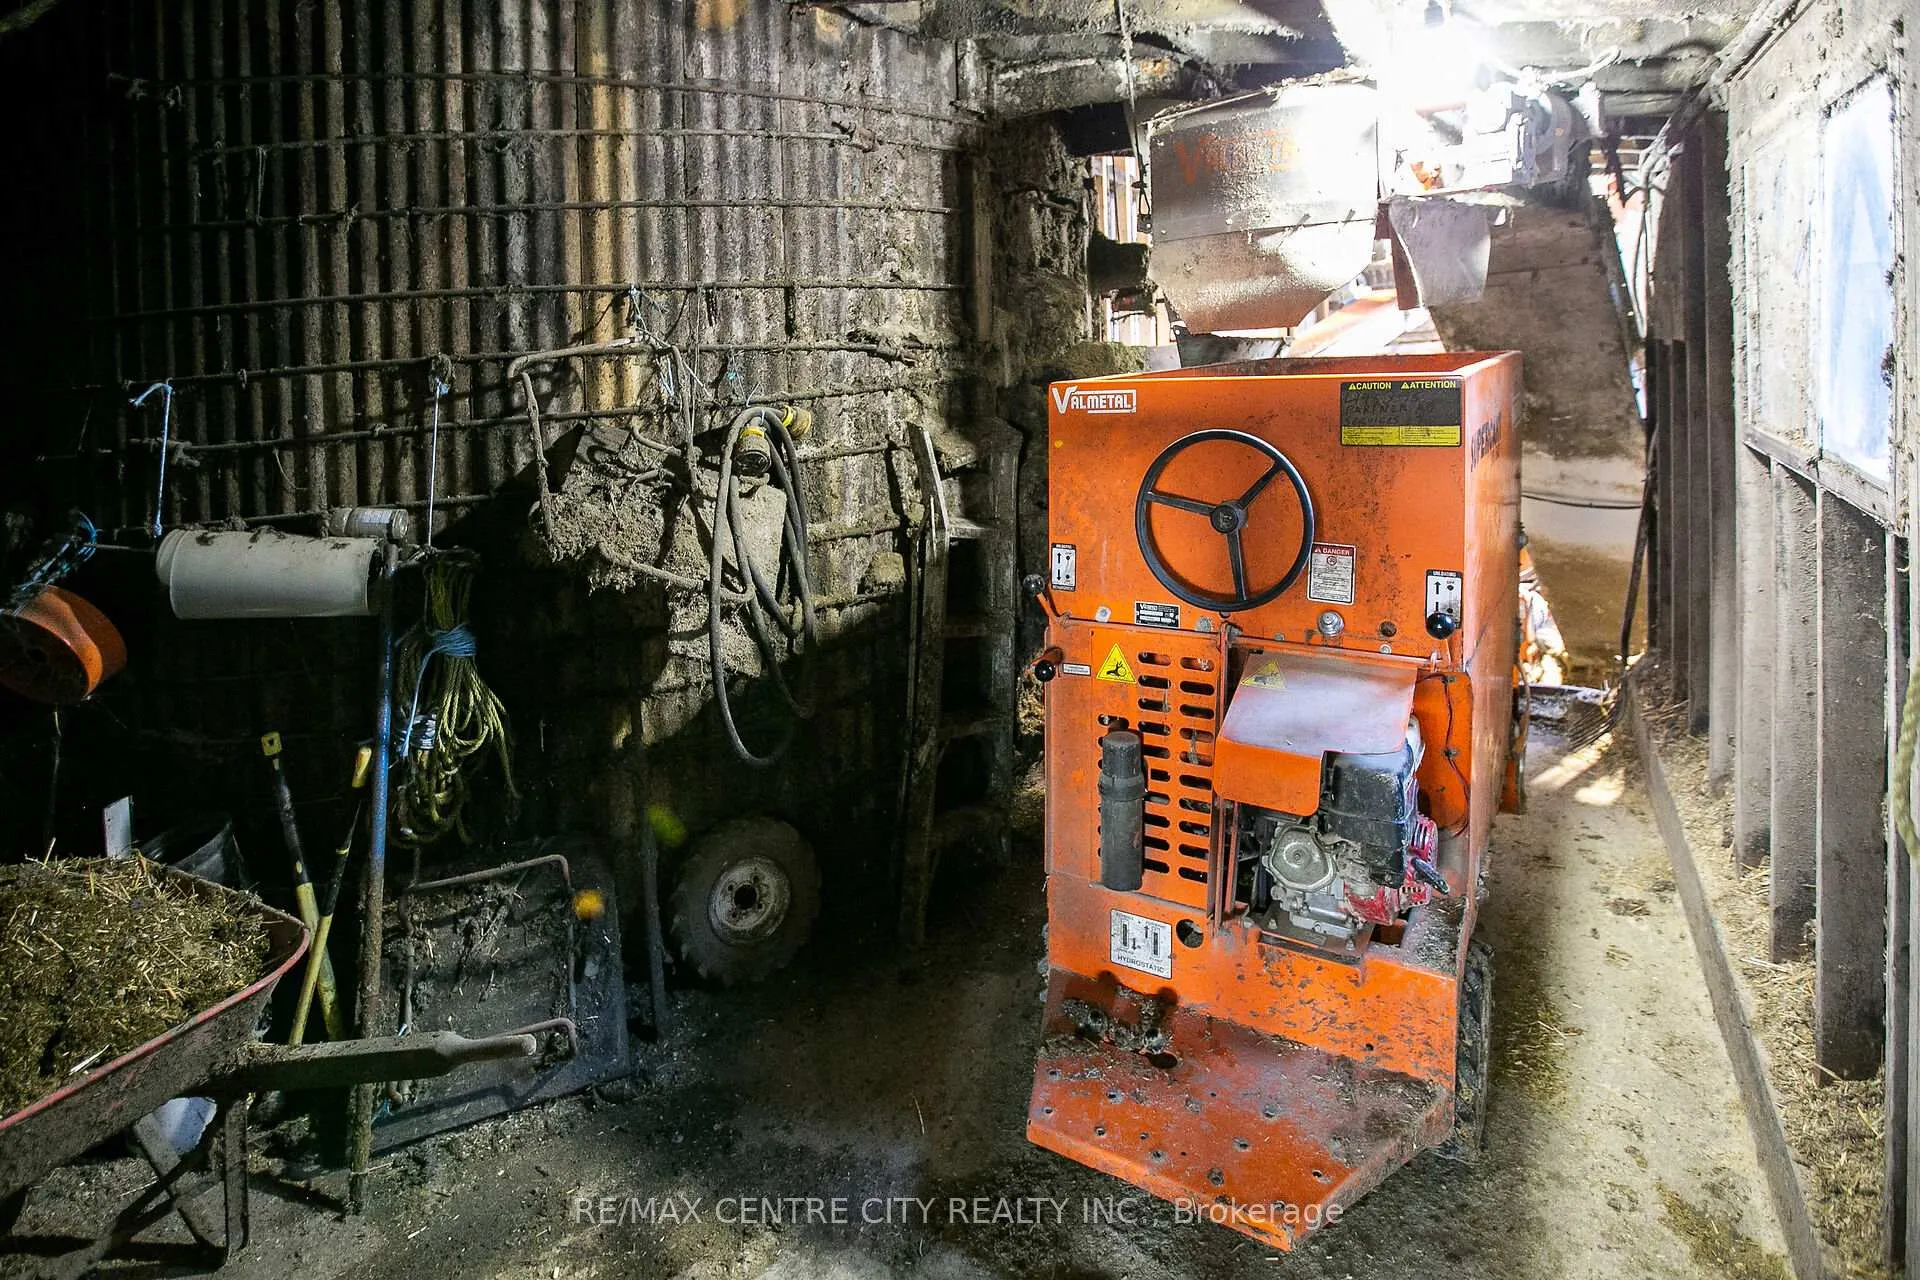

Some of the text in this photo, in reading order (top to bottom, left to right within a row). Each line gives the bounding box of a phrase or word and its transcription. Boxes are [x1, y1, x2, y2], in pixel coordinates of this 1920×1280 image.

[1356, 381, 1392, 390] CAUTION
[1409, 380, 1457, 389] ATTENTION
[1052, 386, 1134, 414] VALMETAL
[1322, 547, 1350, 556] DANGER
[1117, 954, 1165, 974] HYDROSTATIC
